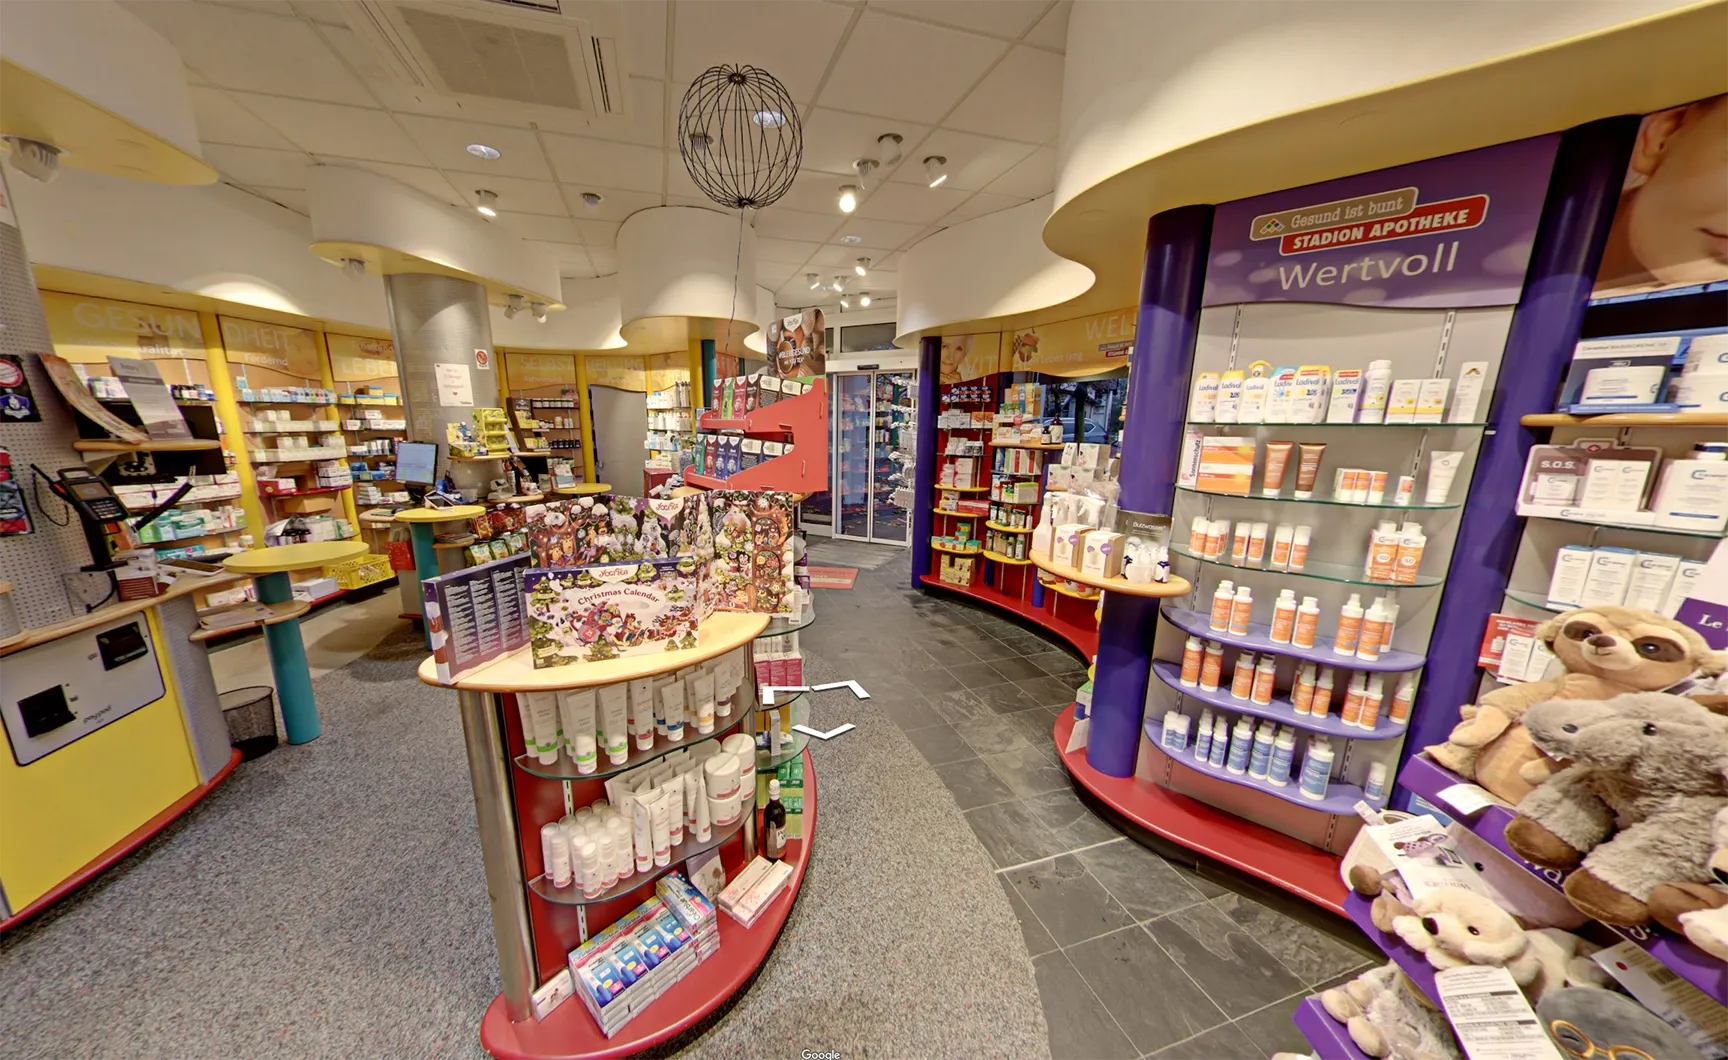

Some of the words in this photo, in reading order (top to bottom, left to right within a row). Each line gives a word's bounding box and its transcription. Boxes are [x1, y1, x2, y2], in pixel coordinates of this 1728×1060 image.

[1291, 208, 1341, 229] Gesund
[1344, 205, 1364, 219] ist
[1368, 196, 1404, 216] bunt
[1292, 227, 1364, 250] STADION
[1369, 209, 1470, 238] APOTHEKE
[1279, 241, 1460, 290] Wertvoll
[1296, 378, 1320, 386] Ladival
[1189, 439, 1201, 478] Sonnenschutz
[577, 589, 622, 606] Christmas
[624, 588, 660, 603] Calendar
